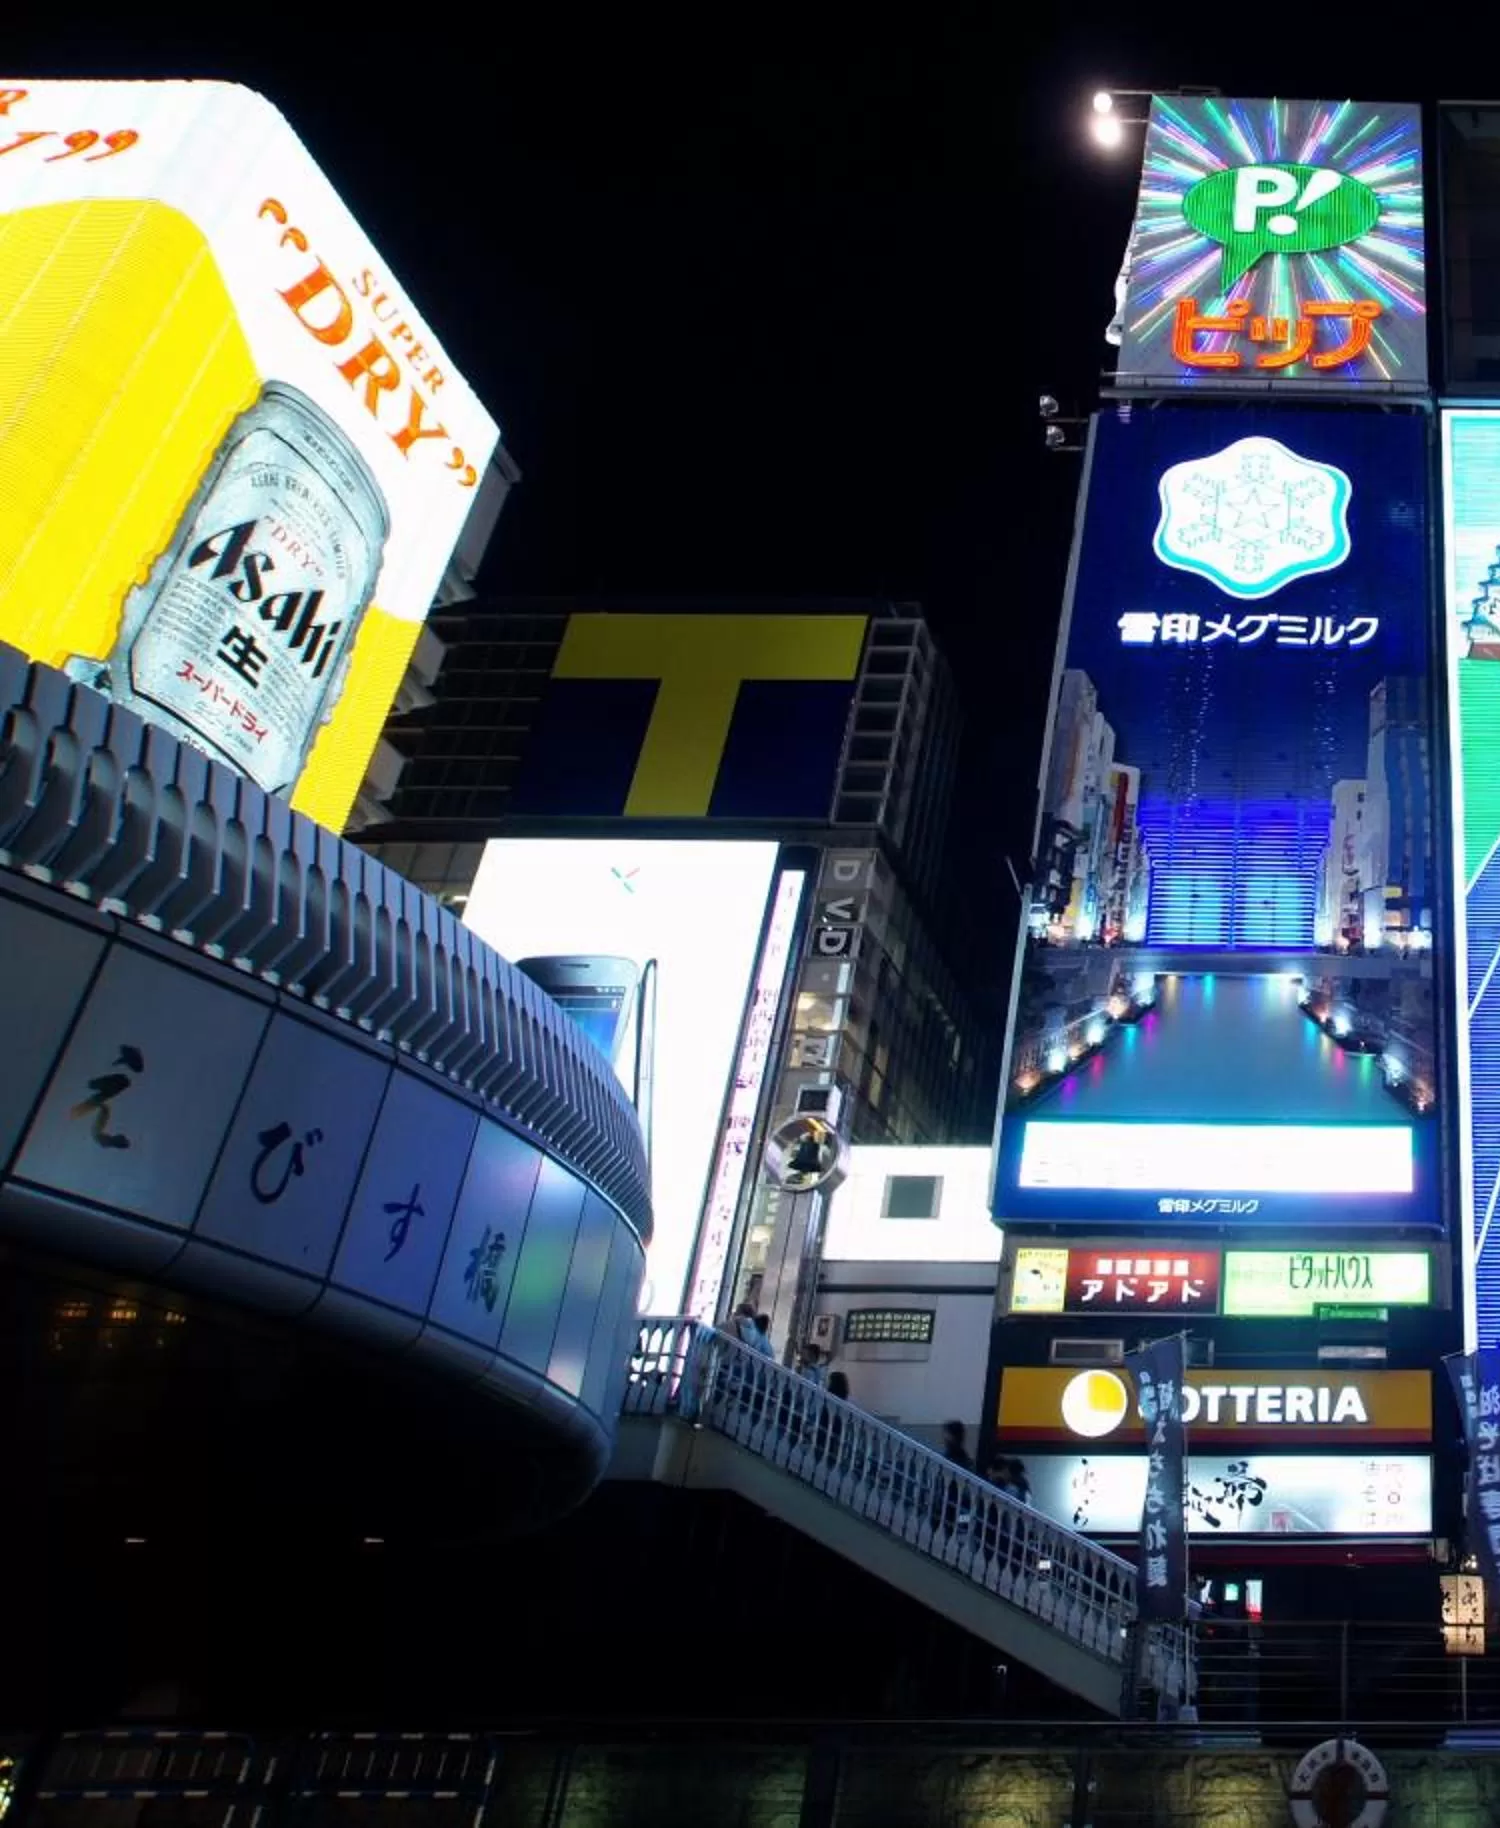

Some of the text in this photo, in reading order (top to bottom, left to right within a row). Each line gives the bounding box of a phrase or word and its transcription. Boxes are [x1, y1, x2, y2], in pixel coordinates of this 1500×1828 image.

[352, 268, 446, 398] SUPER
[1171, 299, 1383, 369] ピップ
[189, 519, 342, 680] Asahi
[1117, 611, 1380, 647] 雪印メグミルク
[217, 625, 269, 690] 生
[175, 659, 269, 747] スーパードライ
[819, 859, 862, 954] DVD
[1081, 1278, 1207, 1303] アドアド
